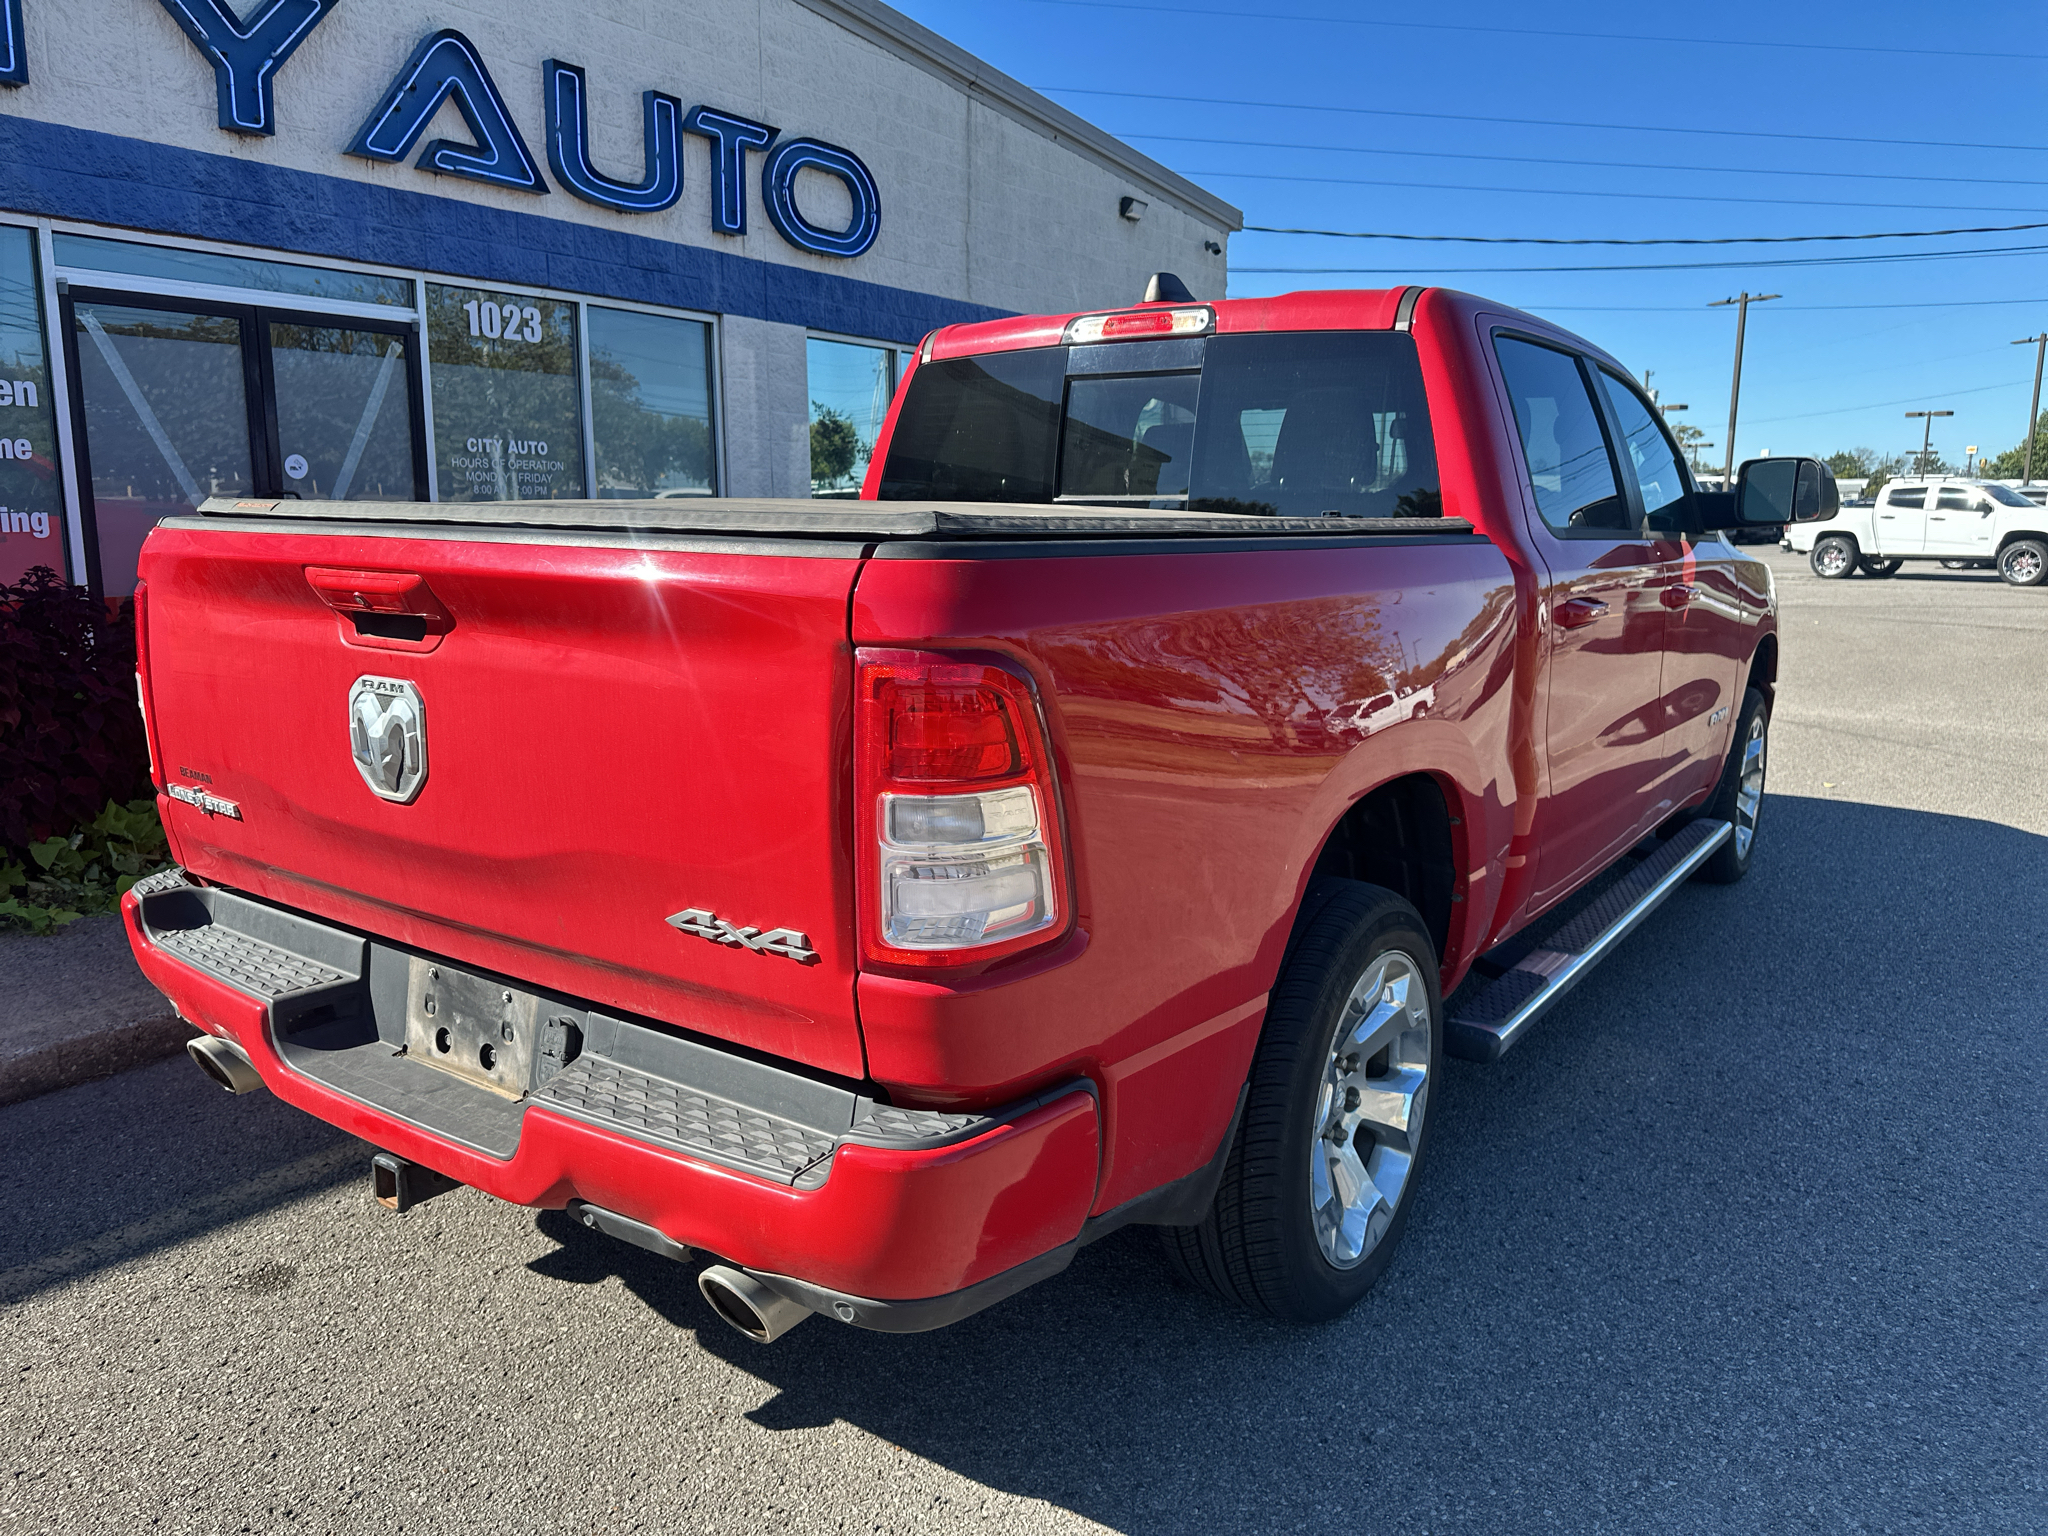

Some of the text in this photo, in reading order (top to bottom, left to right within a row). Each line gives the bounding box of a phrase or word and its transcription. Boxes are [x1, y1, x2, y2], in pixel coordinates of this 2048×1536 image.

[343, 28, 882, 258] AUTO
[463, 300, 542, 343] 1023
[467, 437, 548, 455] CITY AUTO
[452, 458, 564, 471] HOURS OF OPERATION
[466, 472, 553, 483] MONDY FRIDAY
[474, 485, 492, 494] 8:00
[534, 486, 548, 495] PM
[361, 679, 405, 693] RAM
[180, 766, 213, 785] BEAMAN
[203, 796, 236, 818] STAR
